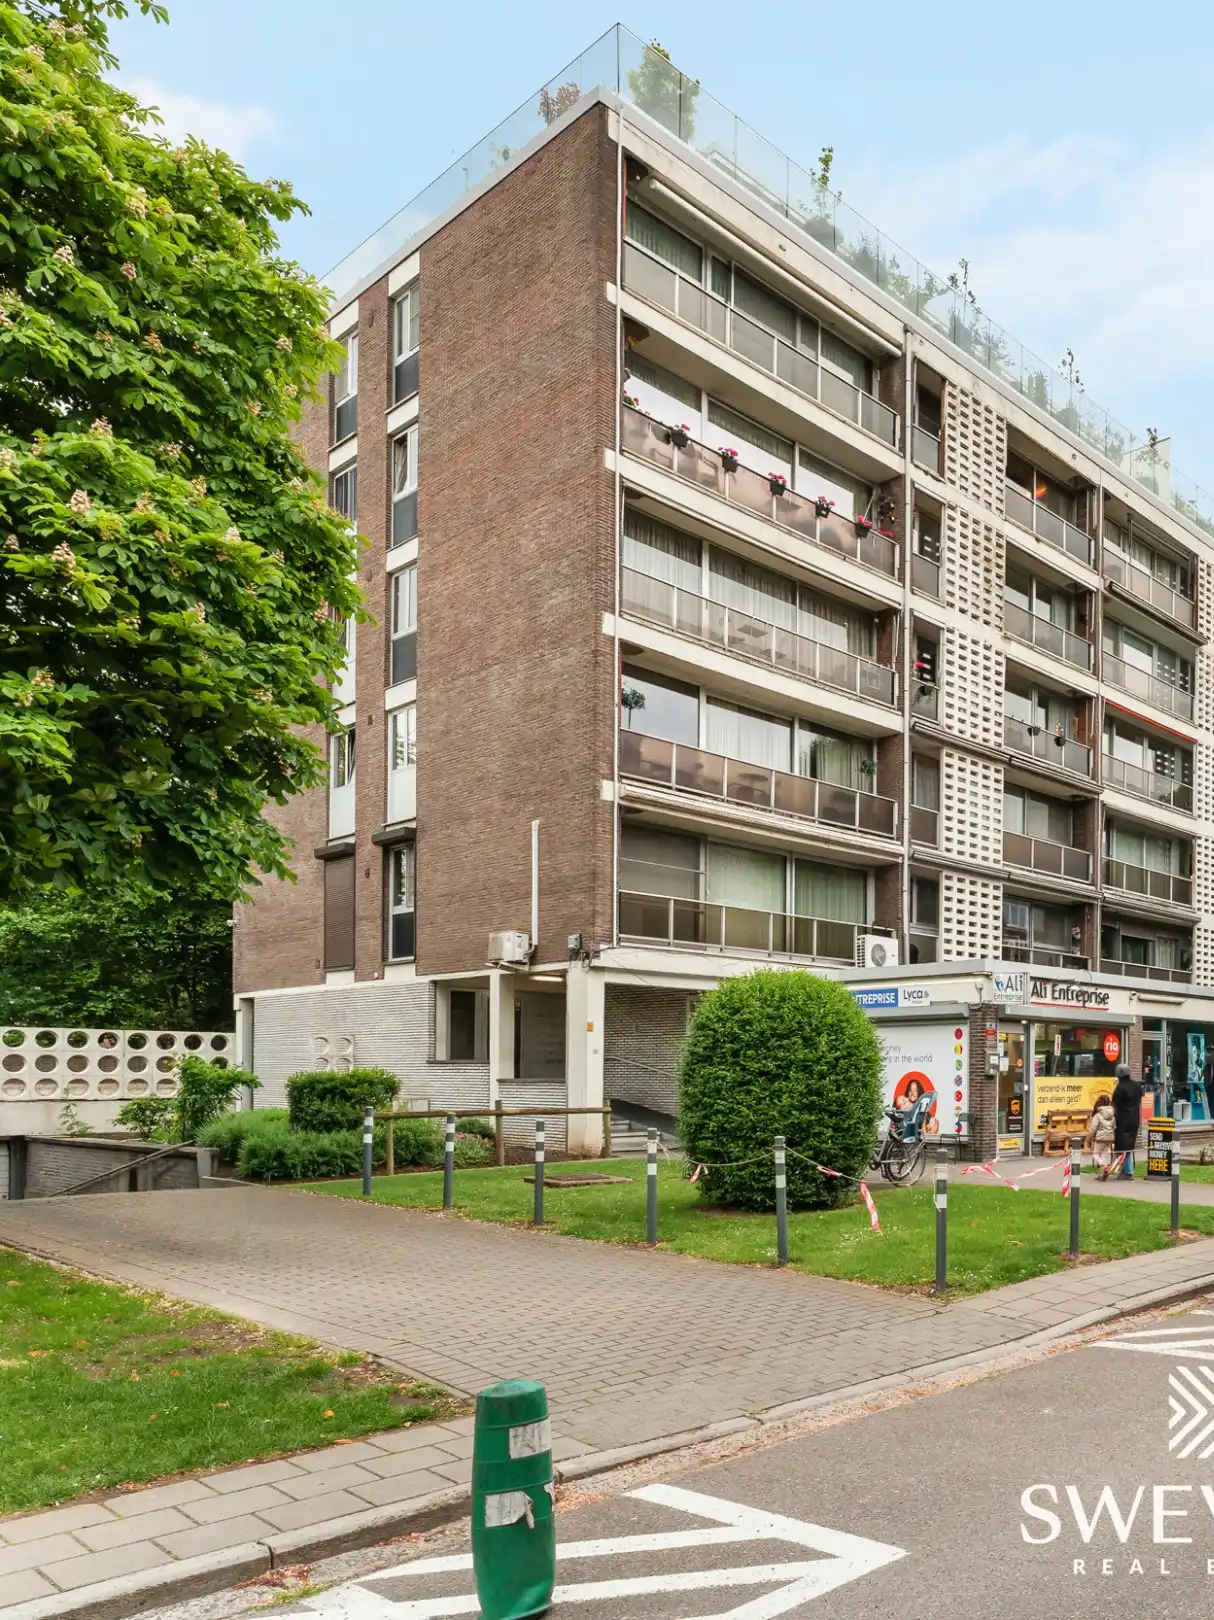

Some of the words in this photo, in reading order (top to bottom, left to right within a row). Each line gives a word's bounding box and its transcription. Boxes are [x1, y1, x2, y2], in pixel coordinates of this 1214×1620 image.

[1005, 975, 1023, 991] Ali
[903, 988, 924, 1001] Lyca
[993, 993, 1023, 1001] Entreprise
[1031, 980, 1048, 999] Ali
[1052, 984, 1110, 1007] Entreprise
[1105, 1037, 1119, 1052] ria
[901, 1055, 912, 1063] the
[913, 1054, 933, 1063] world
[1066, 1084, 1083, 1092] meer
[1149, 1159, 1168, 1171] HERE
